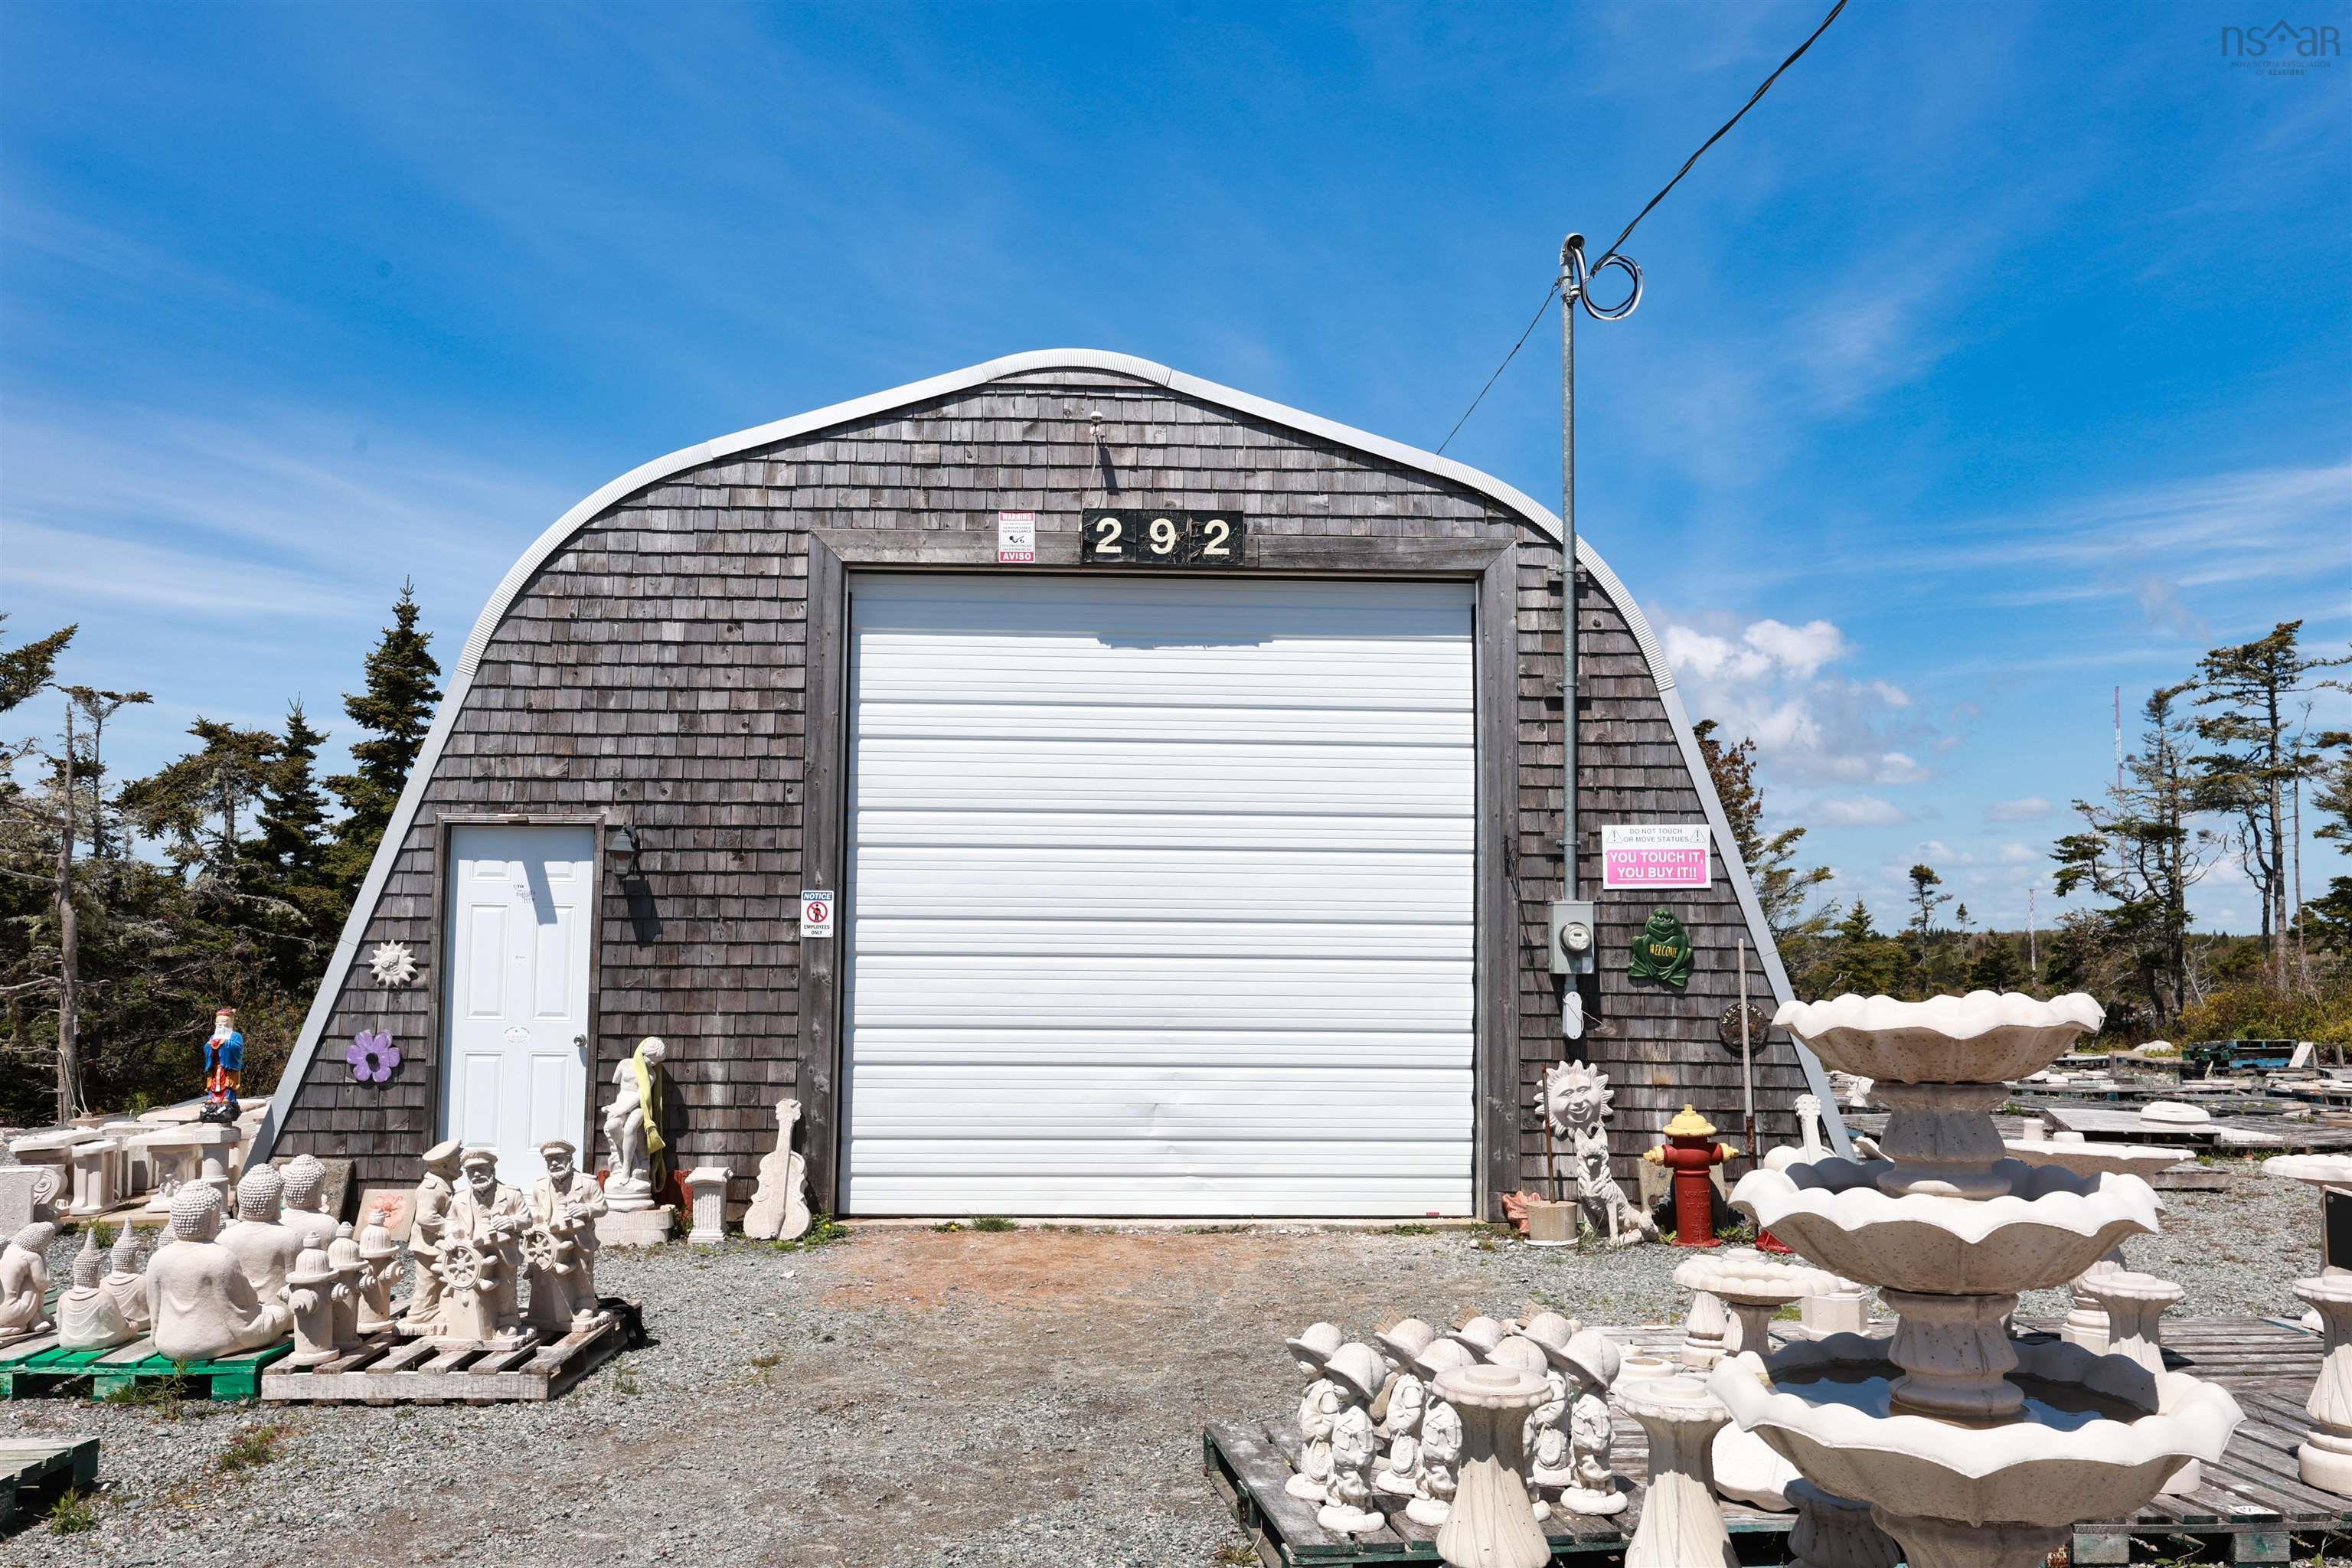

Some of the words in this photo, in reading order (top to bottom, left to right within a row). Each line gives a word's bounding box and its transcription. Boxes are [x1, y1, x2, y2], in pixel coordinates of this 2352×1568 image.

[1003, 552, 1031, 560] AVISO
[1609, 852, 1637, 863] YOU
[1640, 852, 1685, 863] TOUCH
[1689, 852, 1704, 864] IT,
[1617, 867, 1644, 877] YOU
[1648, 867, 1674, 877] BUY
[1677, 867, 1697, 877] IT!!
[1649, 943, 1678, 958] WELCOME
